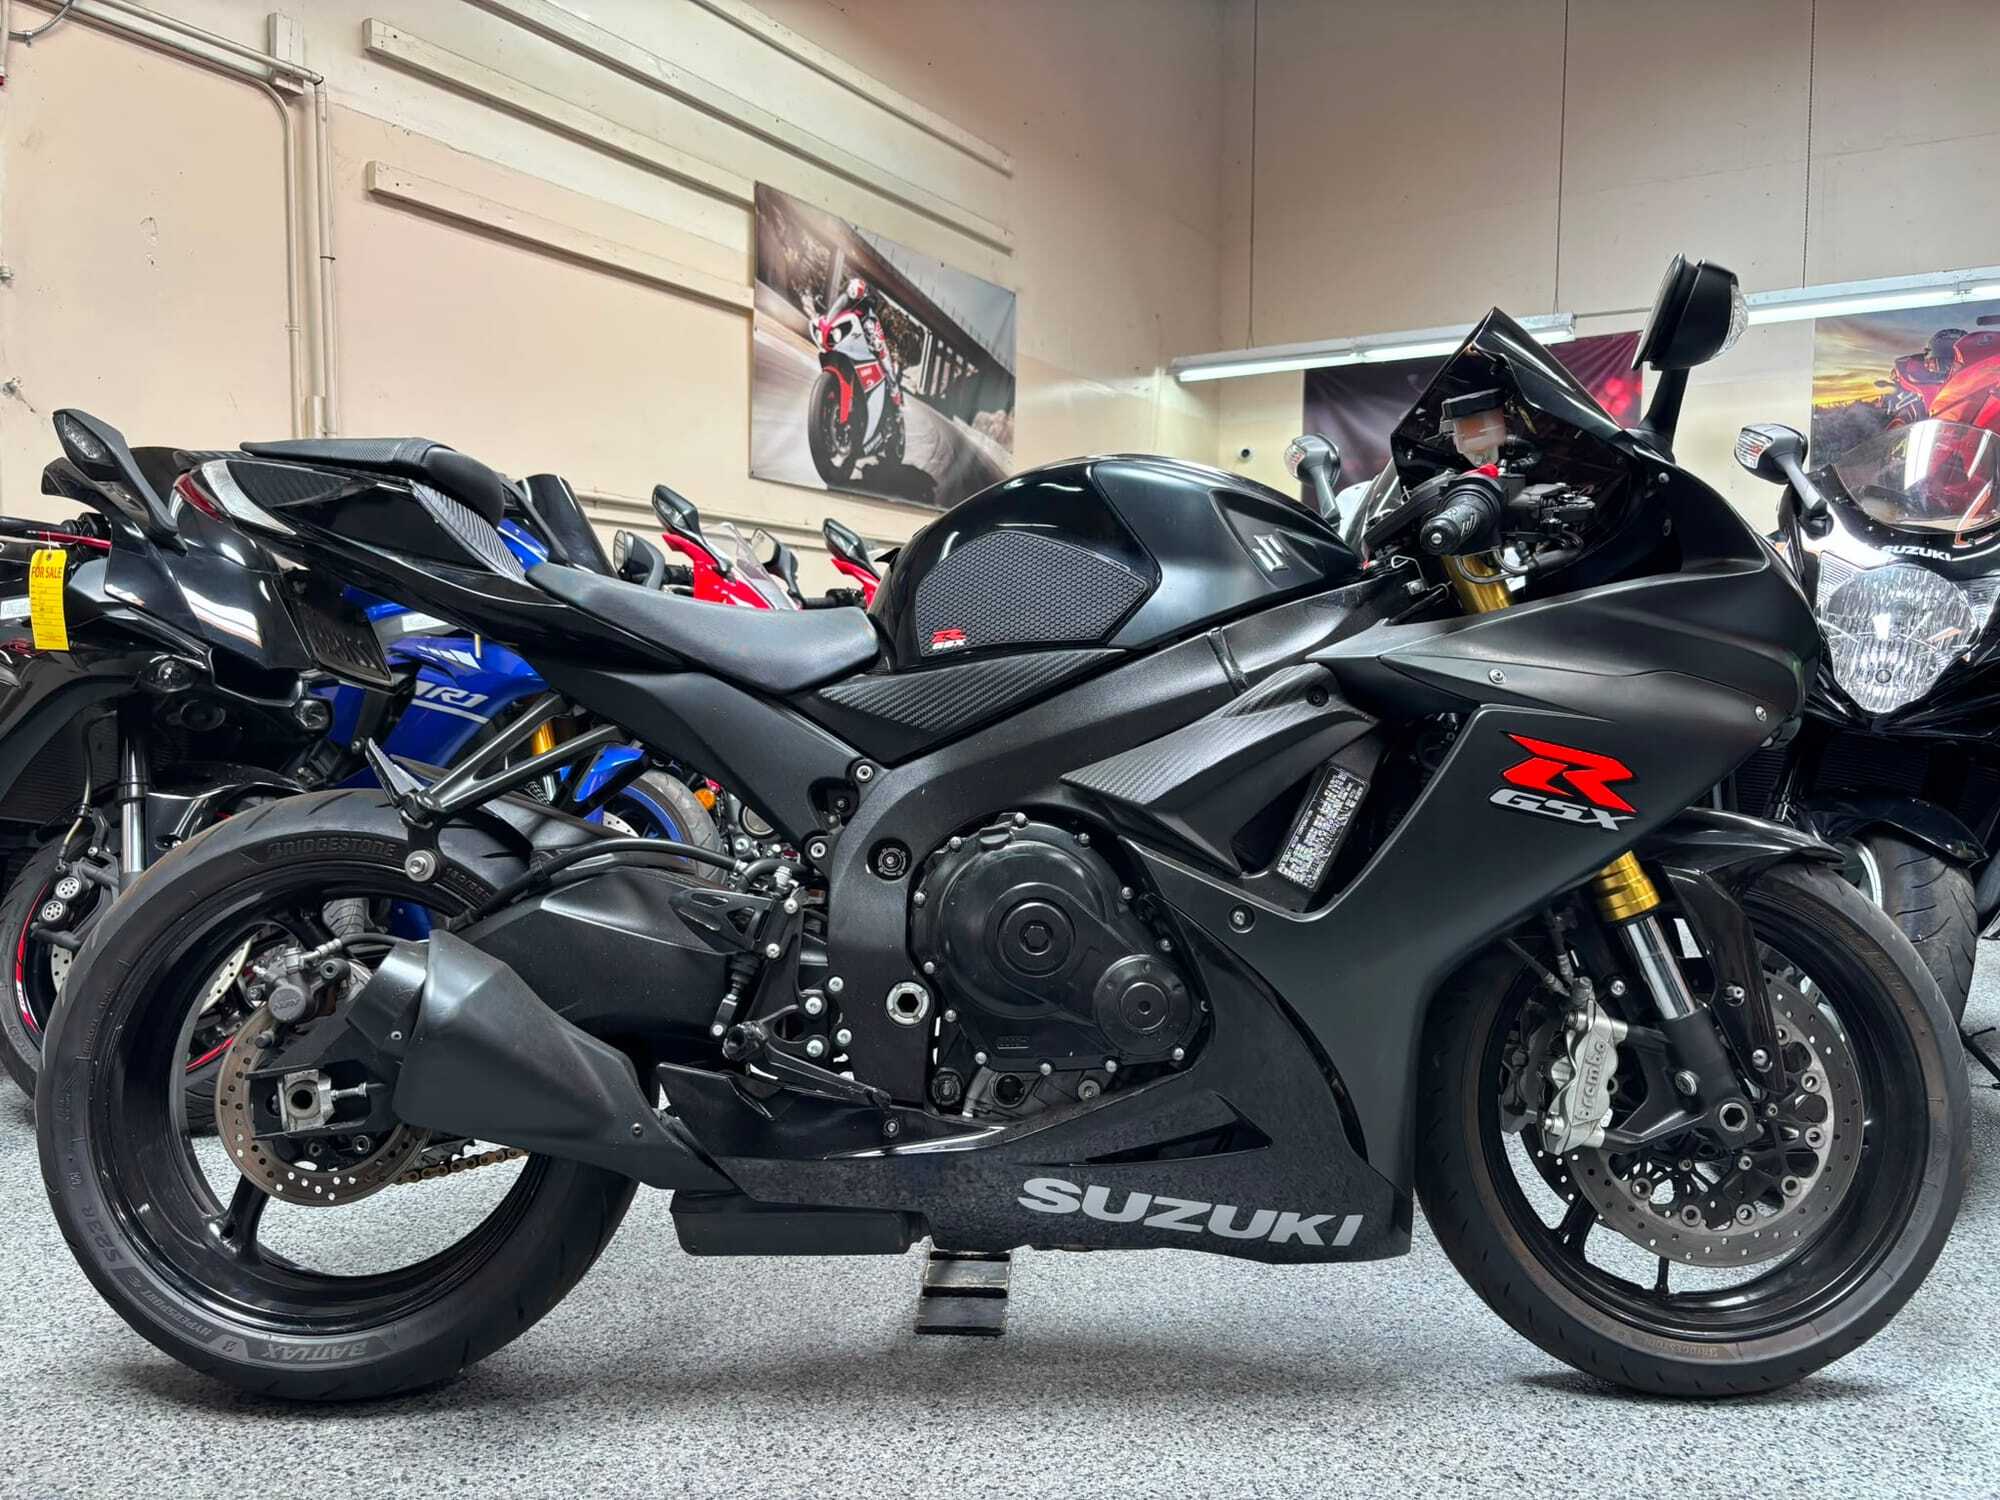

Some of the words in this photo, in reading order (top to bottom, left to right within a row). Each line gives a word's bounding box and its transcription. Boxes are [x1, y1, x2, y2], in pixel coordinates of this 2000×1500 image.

[32, 567, 45, 579] FOR
[46, 567, 62, 579] SALE
[1881, 545, 1952, 561] SUZUKI
[1489, 788, 1636, 831] GSX
[267, 837, 398, 858] BRIDGESTONE
[1574, 1040, 1607, 1120] brembo
[1017, 1178, 1364, 1246] SUZUKI
[140, 1289, 214, 1337] HYPERSPORT
